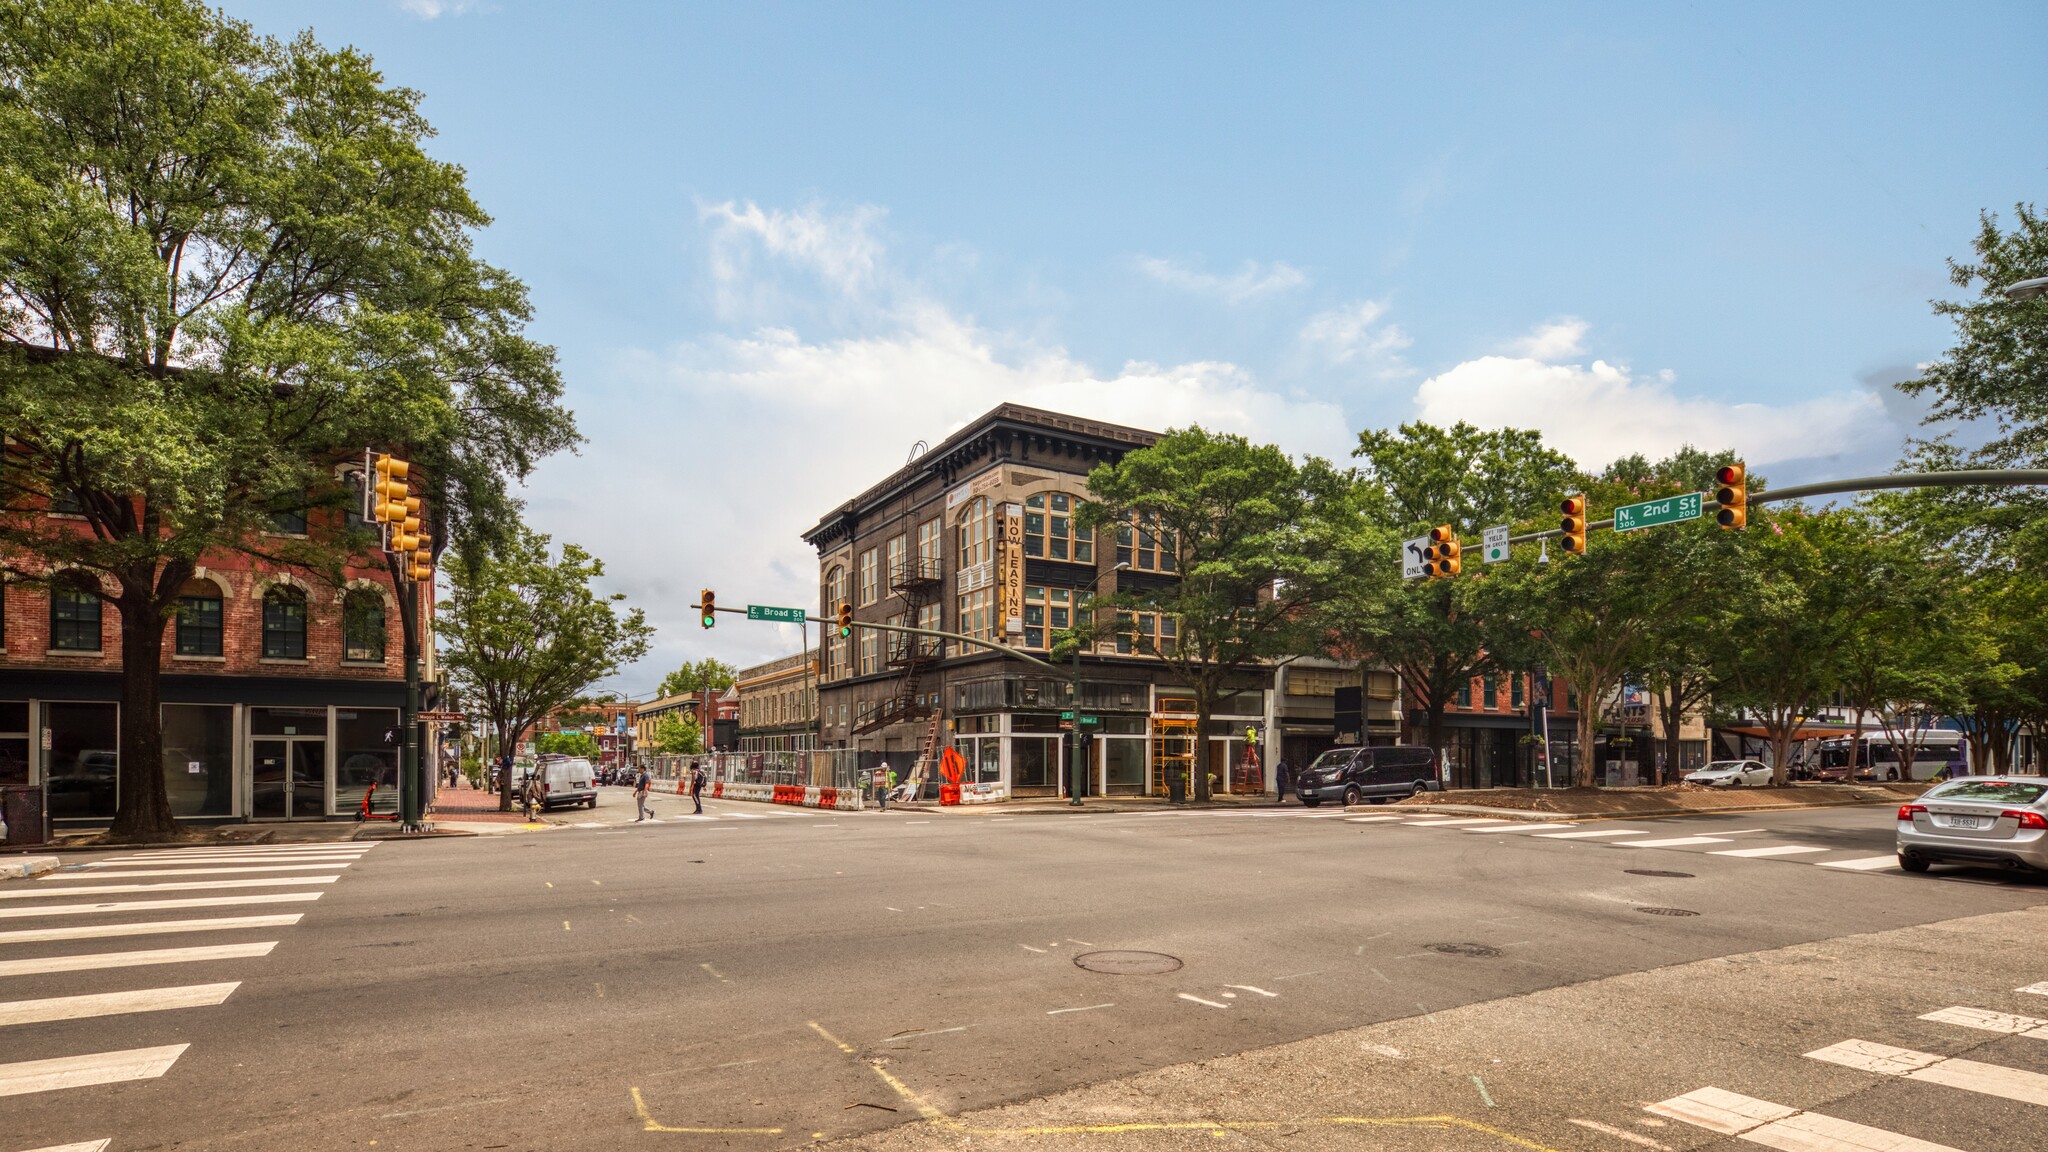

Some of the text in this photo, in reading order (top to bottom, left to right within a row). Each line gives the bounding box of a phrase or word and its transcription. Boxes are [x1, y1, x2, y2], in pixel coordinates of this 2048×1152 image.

[1619, 497, 1696, 521] N. 2nd St
[1679, 509, 1696, 518] 200
[1619, 520, 1635, 528] 300
[1008, 517, 1021, 545] NOW
[1488, 534, 1503, 543] YIELD
[1009, 550, 1019, 617] LEASING
[750, 606, 802, 618] E. Broad St
